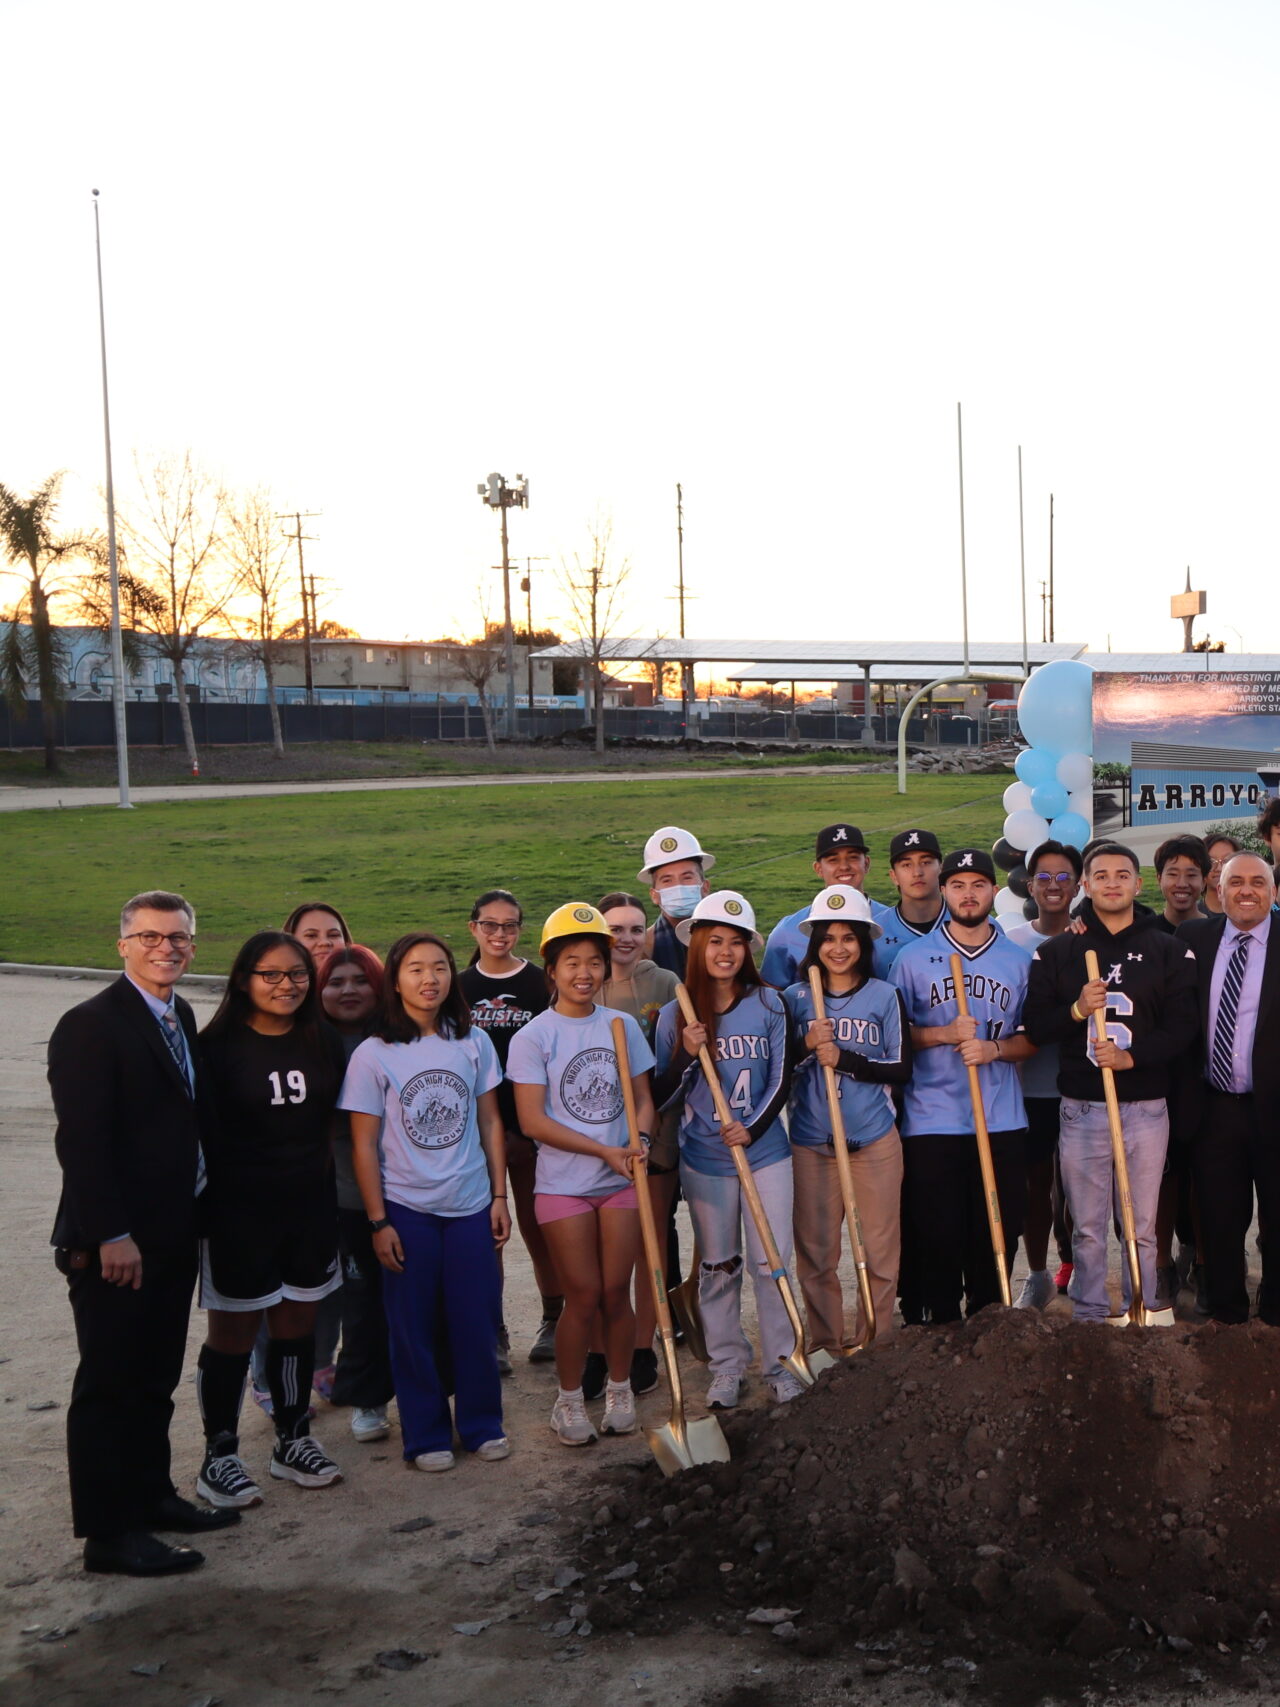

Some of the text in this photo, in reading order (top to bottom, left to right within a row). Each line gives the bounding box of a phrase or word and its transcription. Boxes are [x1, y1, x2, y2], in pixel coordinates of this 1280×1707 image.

[1139, 674, 1172, 682] THANK
[1175, 673, 1195, 682] YOU
[1197, 673, 1218, 682] FOR
[1220, 673, 1271, 682] INVESTING
[1210, 684, 1250, 693] FUNDED
[1252, 684, 1266, 692] BY
[1228, 704, 1266, 712] ATHLETIC
[1137, 783, 1259, 812] ARROYO
[832, 828, 848, 842] A
[905, 832, 920, 846] A
[957, 853, 973, 867] A
[1100, 963, 1122, 984] A
[470, 1010, 532, 1022] OLLISTER
[716, 1034, 770, 1061] ROYO
[565, 1058, 587, 1085] ARROYO
[585, 1052, 603, 1063] HIGH
[268, 1070, 306, 1105] 19
[403, 1074, 468, 1107] ARROYO HIGH SCHOOL
[568, 1096, 593, 1119] CROSS
[405, 1119, 429, 1143] CROSS
